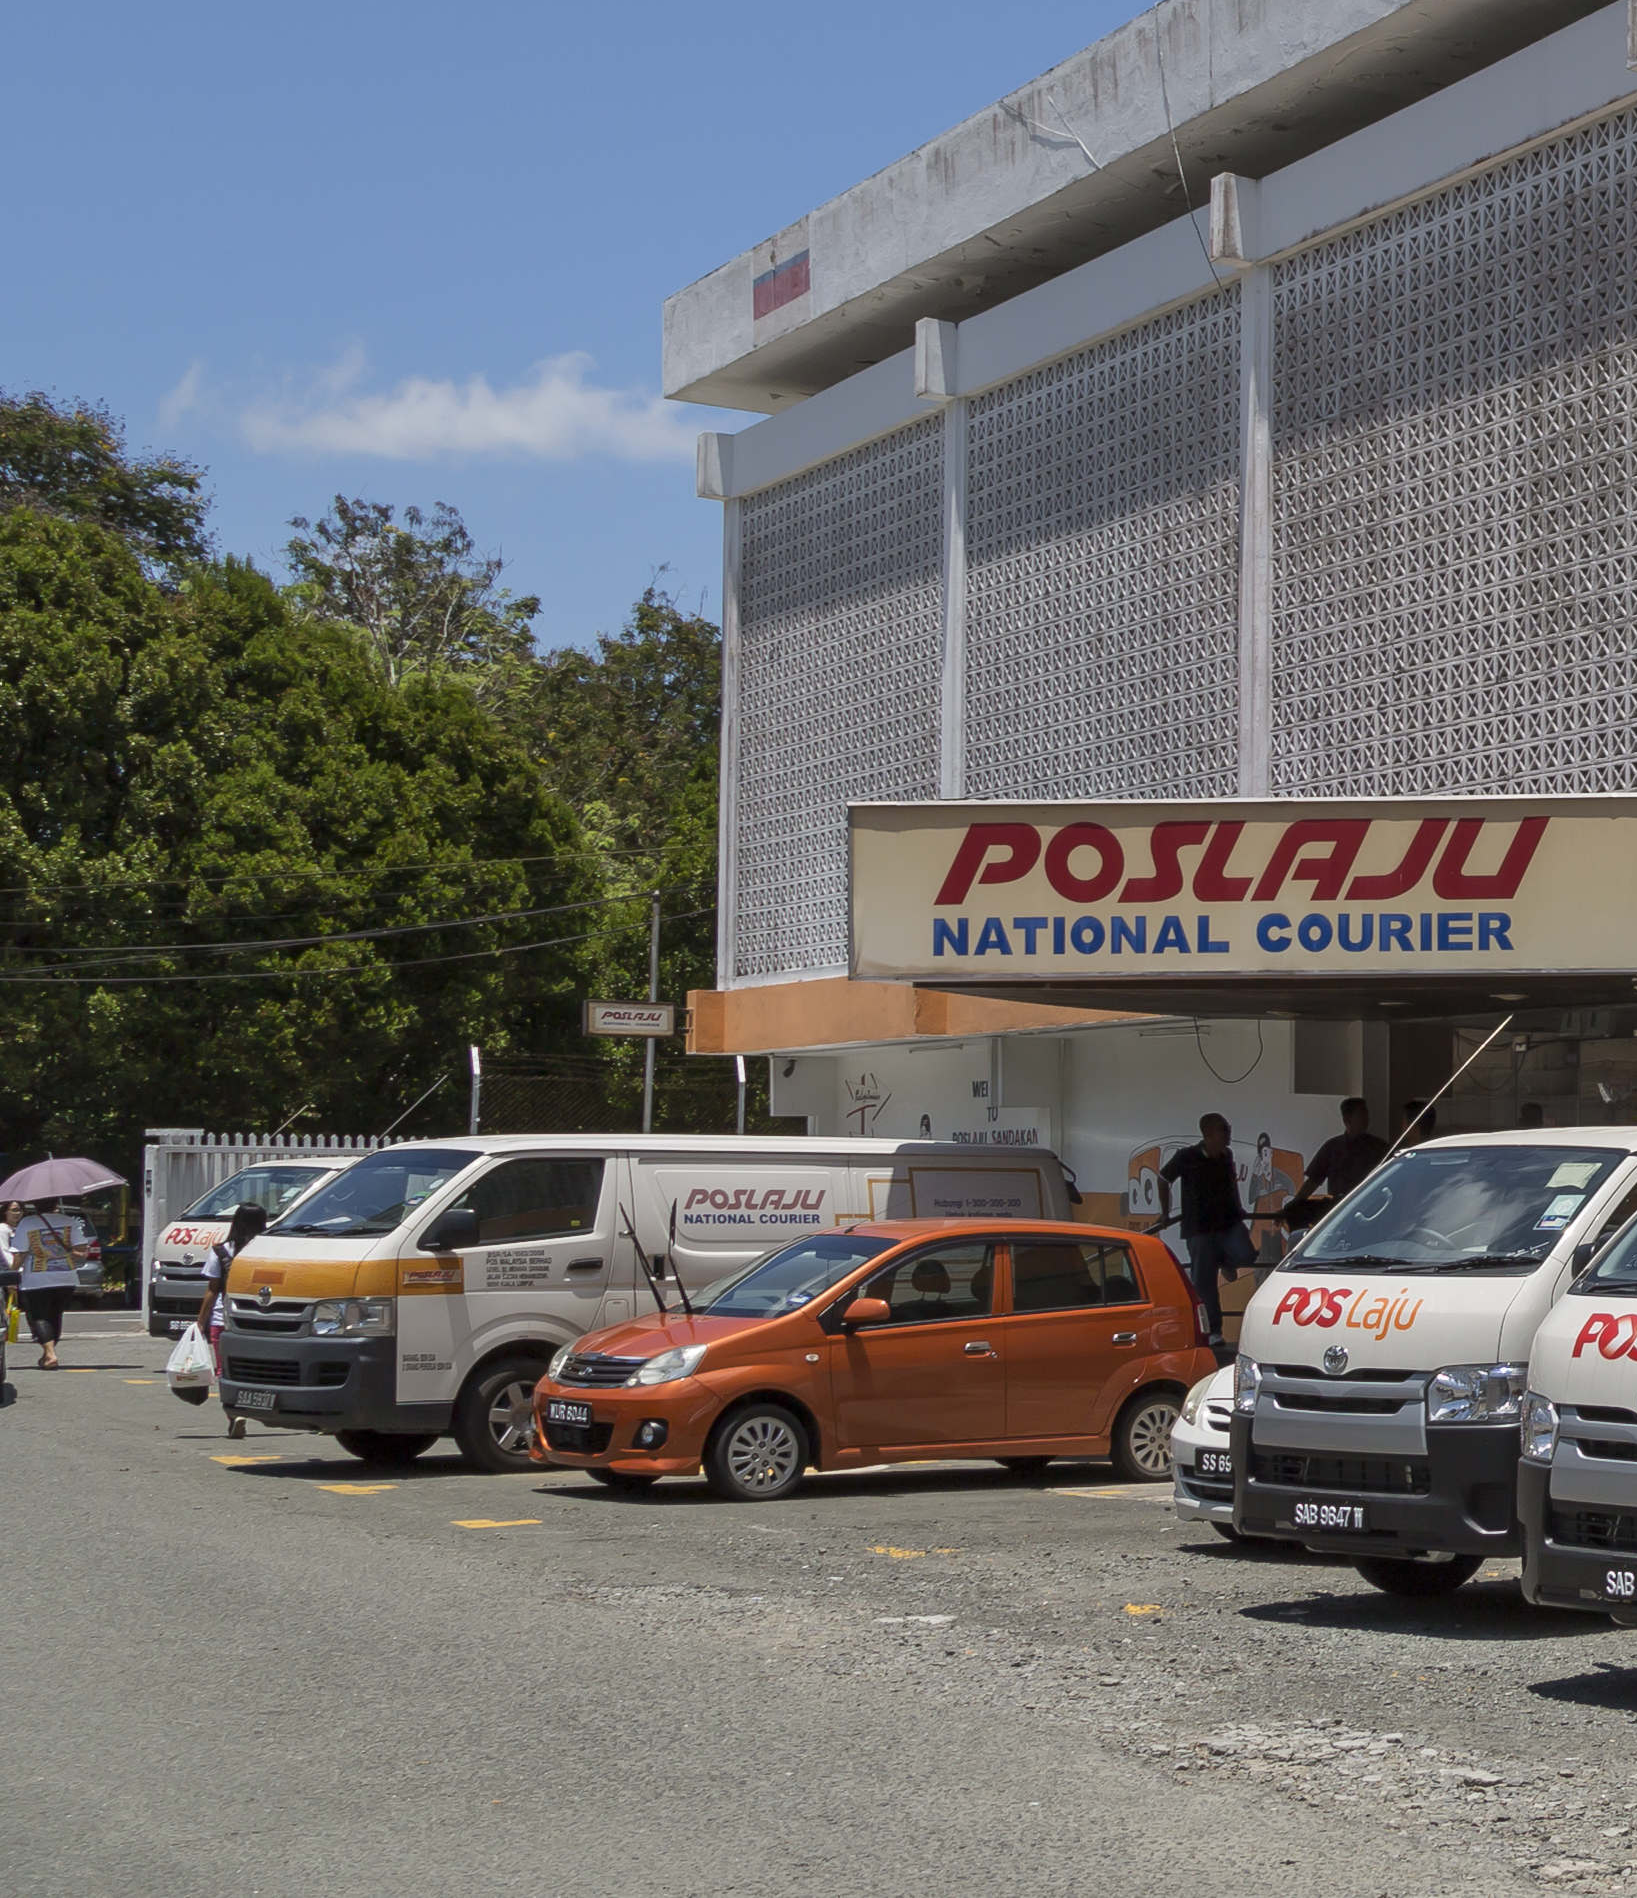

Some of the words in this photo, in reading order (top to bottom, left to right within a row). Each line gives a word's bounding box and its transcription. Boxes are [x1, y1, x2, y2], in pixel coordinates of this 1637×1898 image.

[934, 816, 1551, 906] POSLAJU
[933, 915, 1230, 957] NATIONAL
[1256, 912, 1515, 953] COURIER
[601, 1011, 662, 1022] POSLAJU
[991, 1127, 1039, 1146] SANDAKAN
[684, 1188, 826, 1211] POSLAJU
[684, 1213, 756, 1225] NATIONAL
[759, 1213, 821, 1225] COURIER
[165, 1227, 198, 1246] POS
[193, 1227, 226, 1251] Laju
[1272, 1286, 1353, 1328] POS
[1345, 1287, 1424, 1341] Laju
[1202, 1453, 1217, 1471] SS
[1294, 1503, 1318, 1525] SAB
[1319, 1505, 1351, 1528] 9647
[1606, 1570, 1635, 1596] SAB
